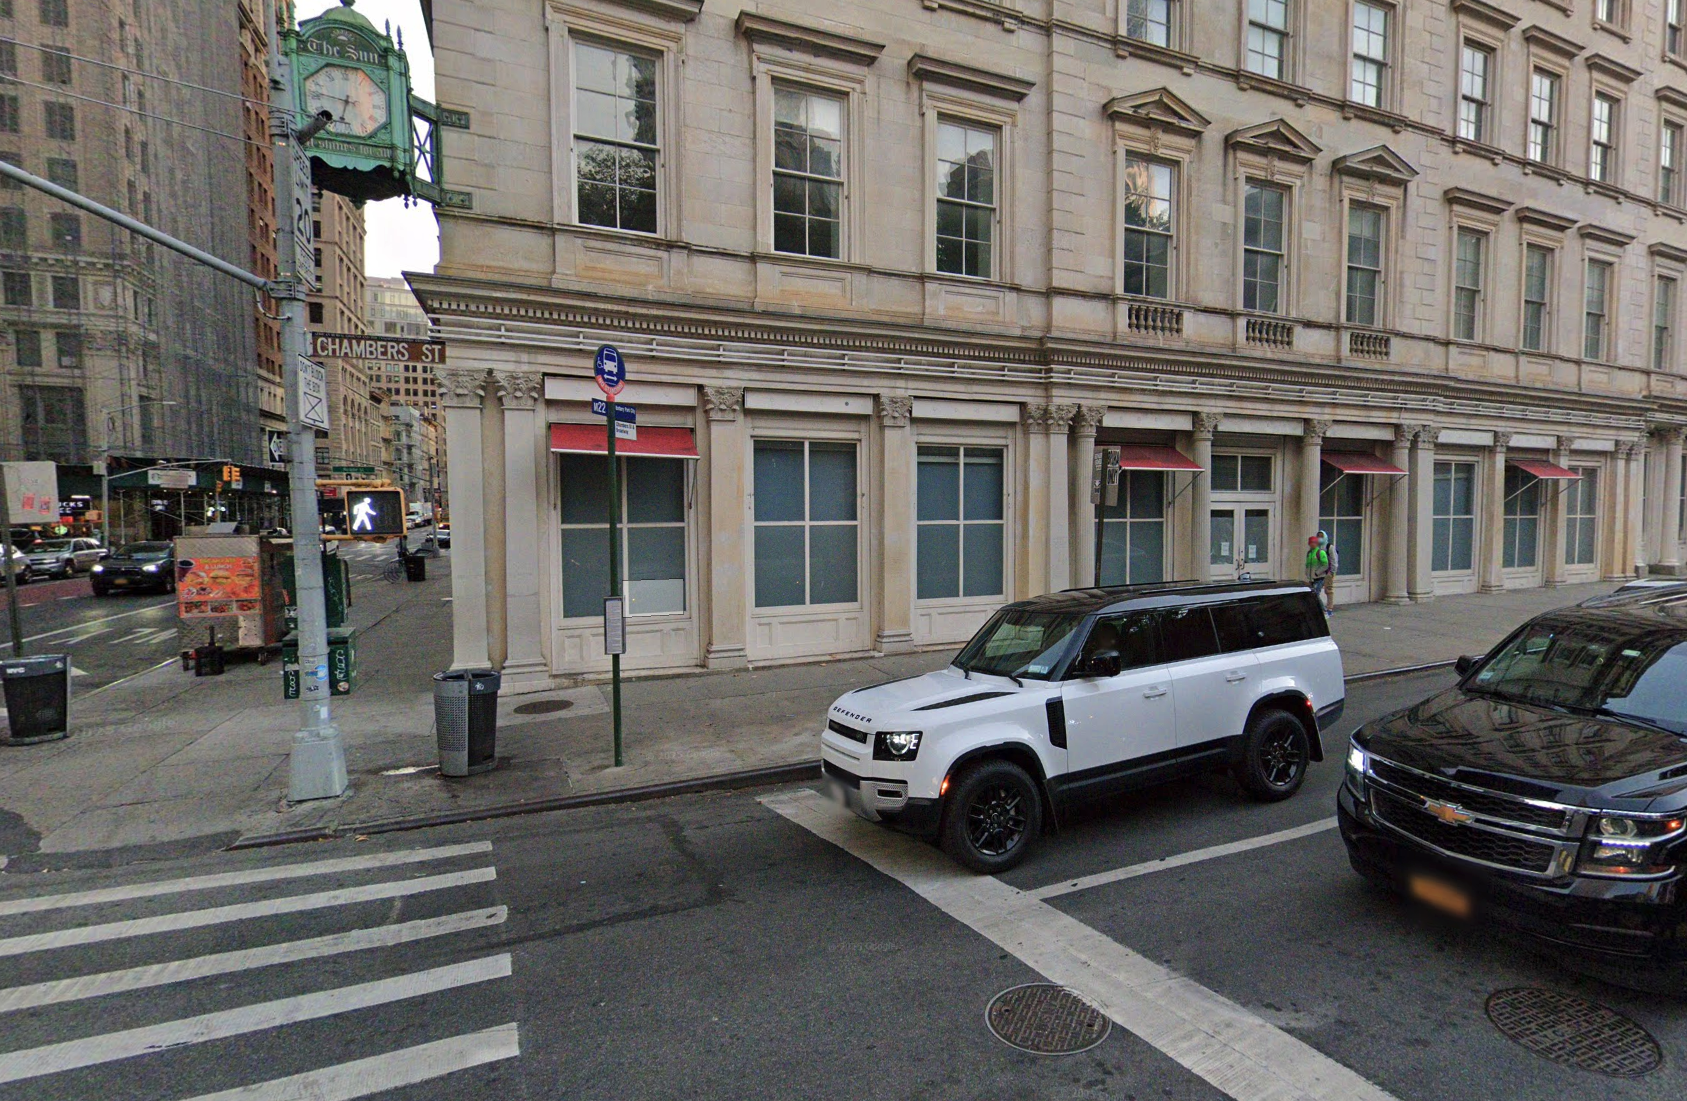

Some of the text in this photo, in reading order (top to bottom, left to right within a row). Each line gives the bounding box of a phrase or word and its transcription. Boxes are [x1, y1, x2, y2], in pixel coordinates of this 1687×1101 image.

[307, 37, 379, 64] The Sun
[295, 197, 311, 245] 20
[316, 337, 409, 362] CHAMBERS
[421, 344, 442, 363] ST
[311, 364, 324, 382] BLOCK
[303, 377, 321, 394] THE BOX
[593, 401, 606, 414] M22
[832, 706, 873, 724] DEFENDER
